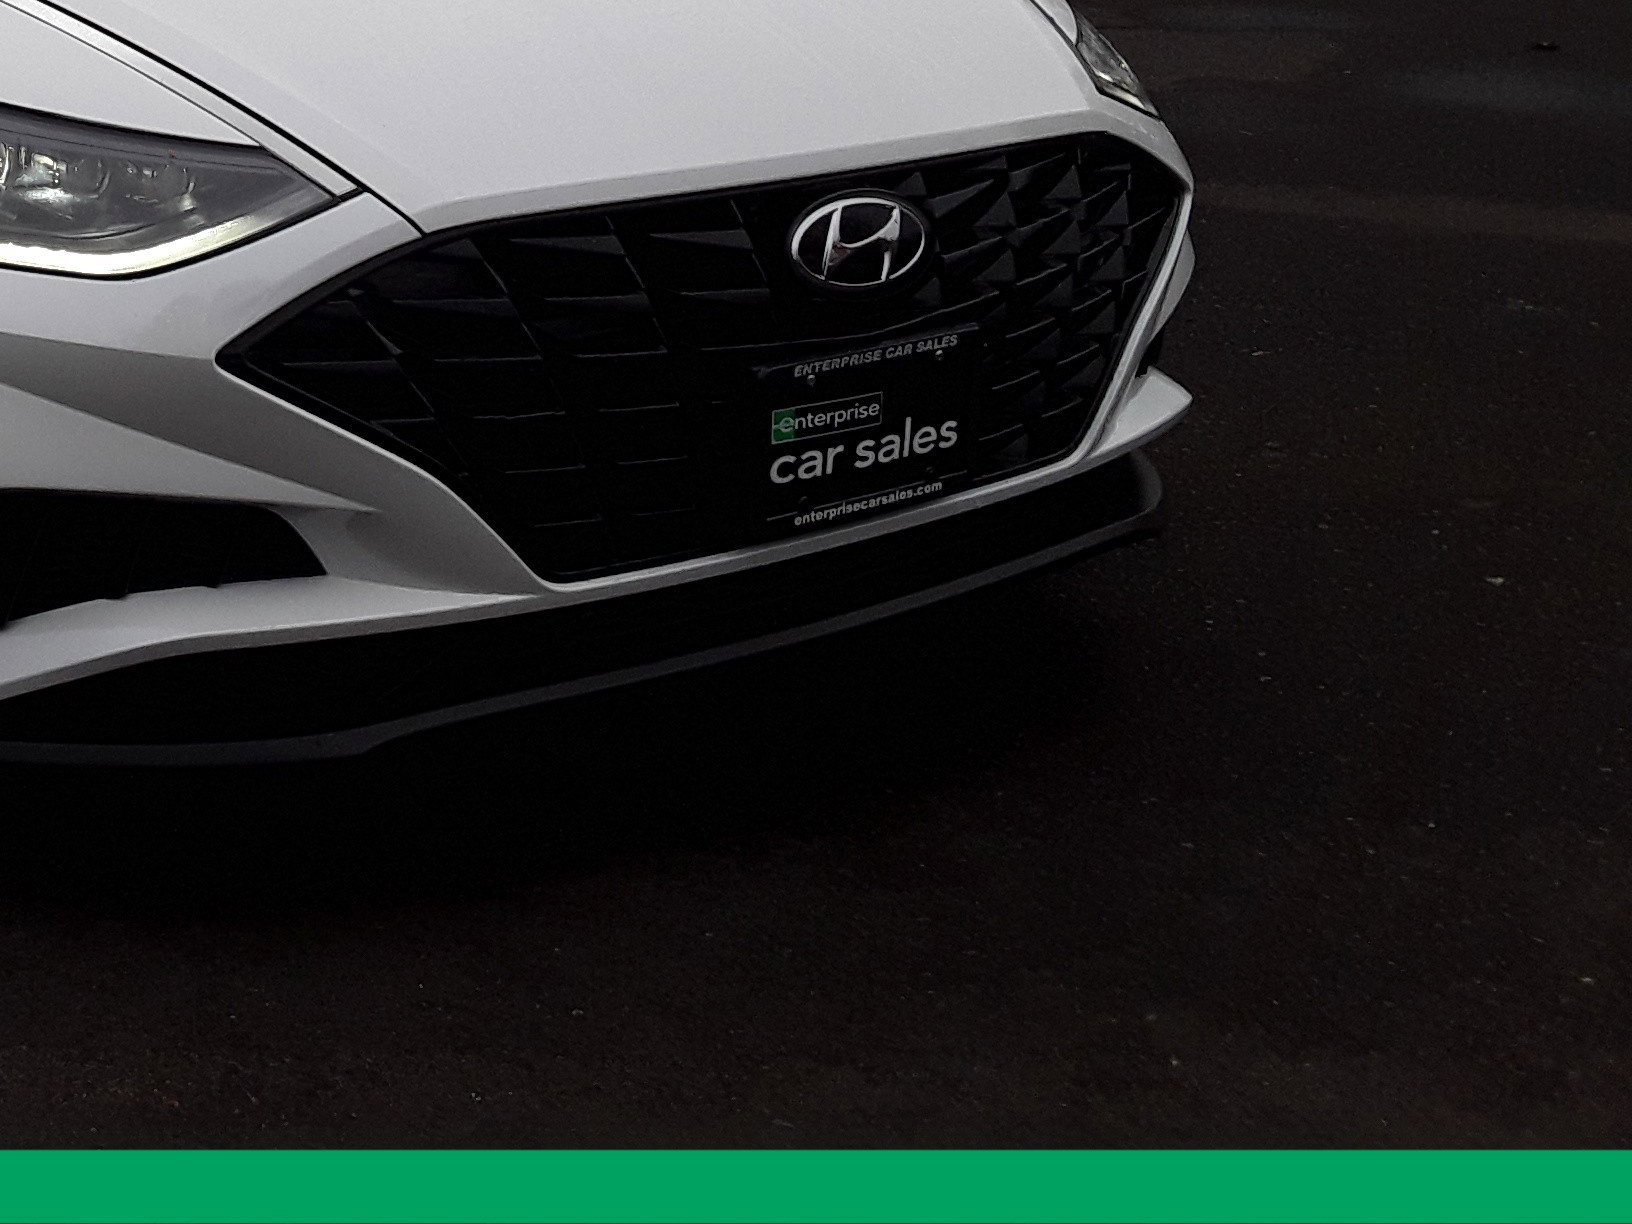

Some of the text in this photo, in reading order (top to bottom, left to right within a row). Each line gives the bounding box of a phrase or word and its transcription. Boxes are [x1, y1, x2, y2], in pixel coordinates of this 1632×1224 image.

[794, 334, 958, 378] ENTERPRISE CAR SALES
[776, 402, 881, 433] enterprise
[769, 416, 958, 484] car sales
[794, 481, 943, 526] enterprisecarsales.com
